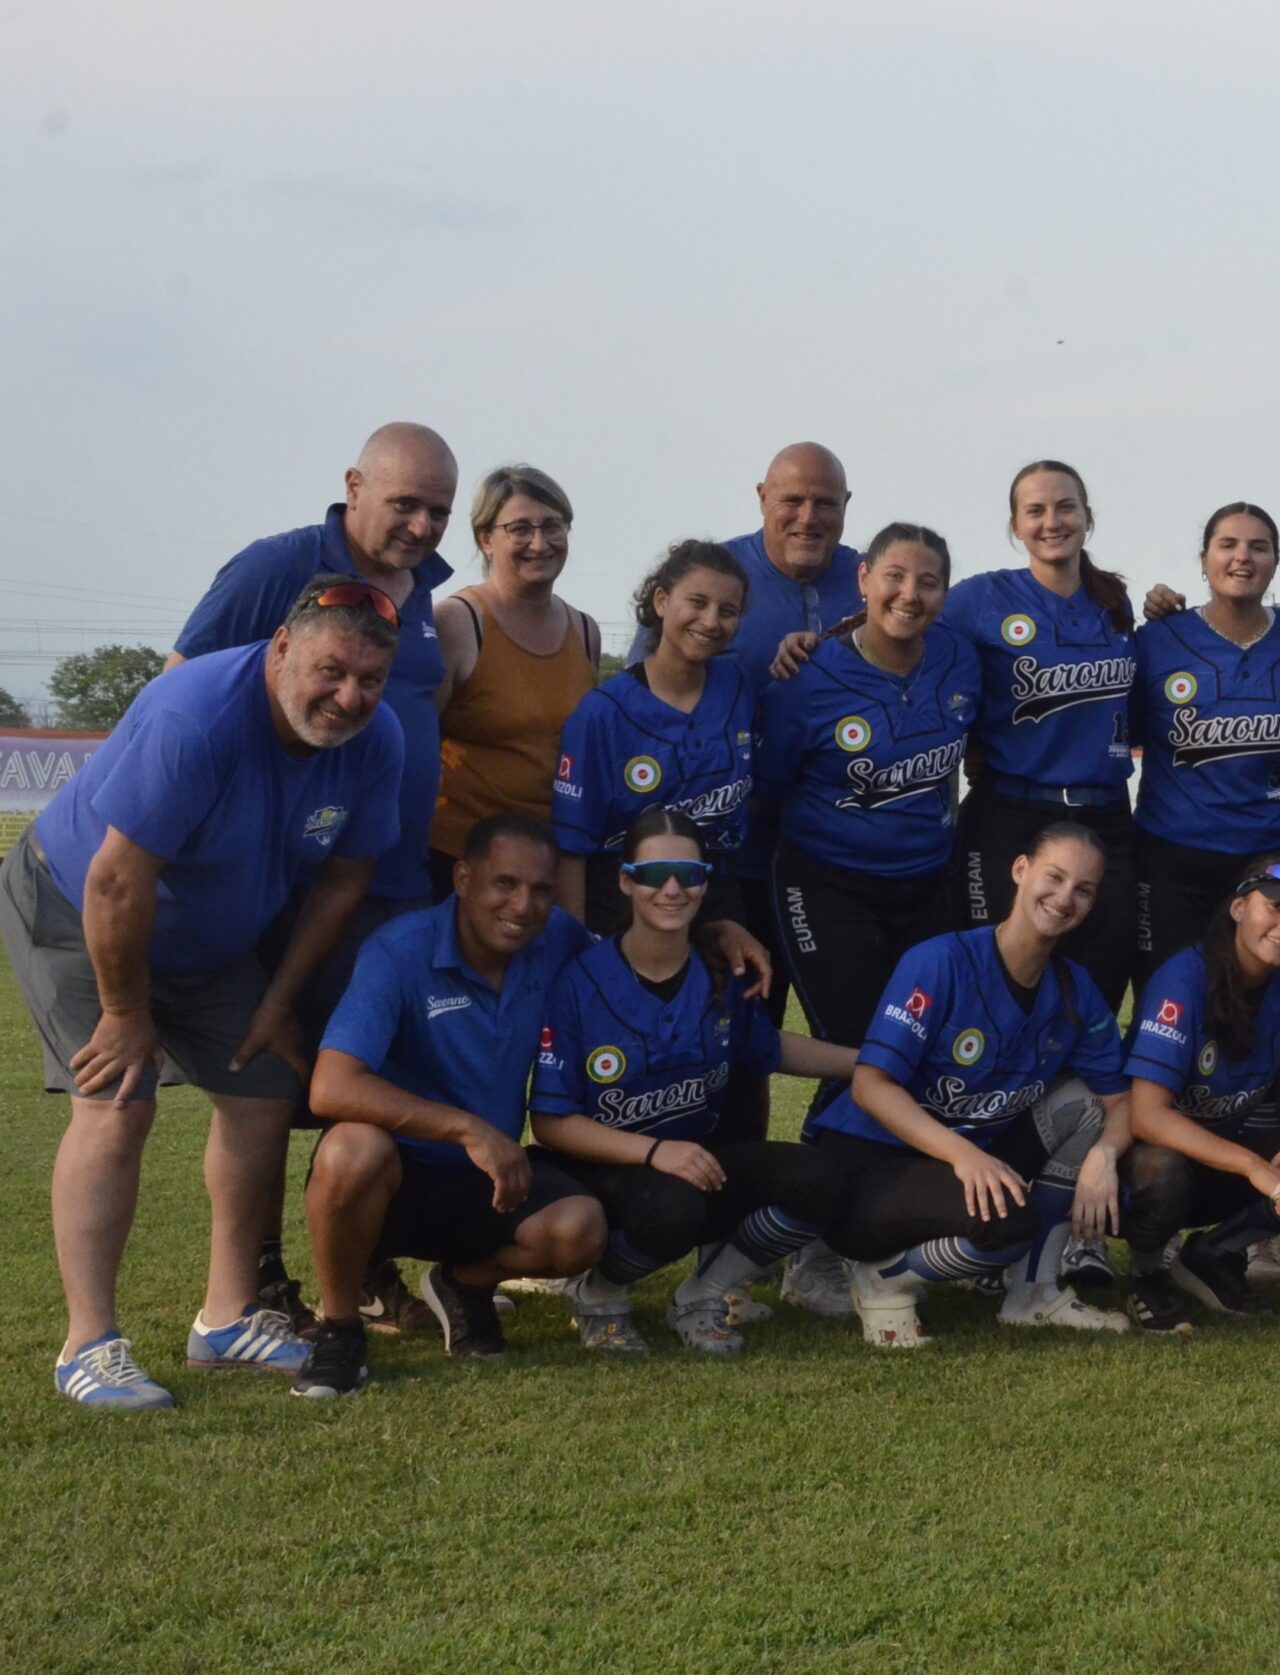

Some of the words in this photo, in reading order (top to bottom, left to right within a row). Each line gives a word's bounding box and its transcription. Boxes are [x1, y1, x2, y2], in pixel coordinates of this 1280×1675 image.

[0, 750, 93, 790] AVA
[847, 733, 968, 794] Saronn
[968, 852, 988, 920] EURAM
[786, 887, 817, 953] EURAM
